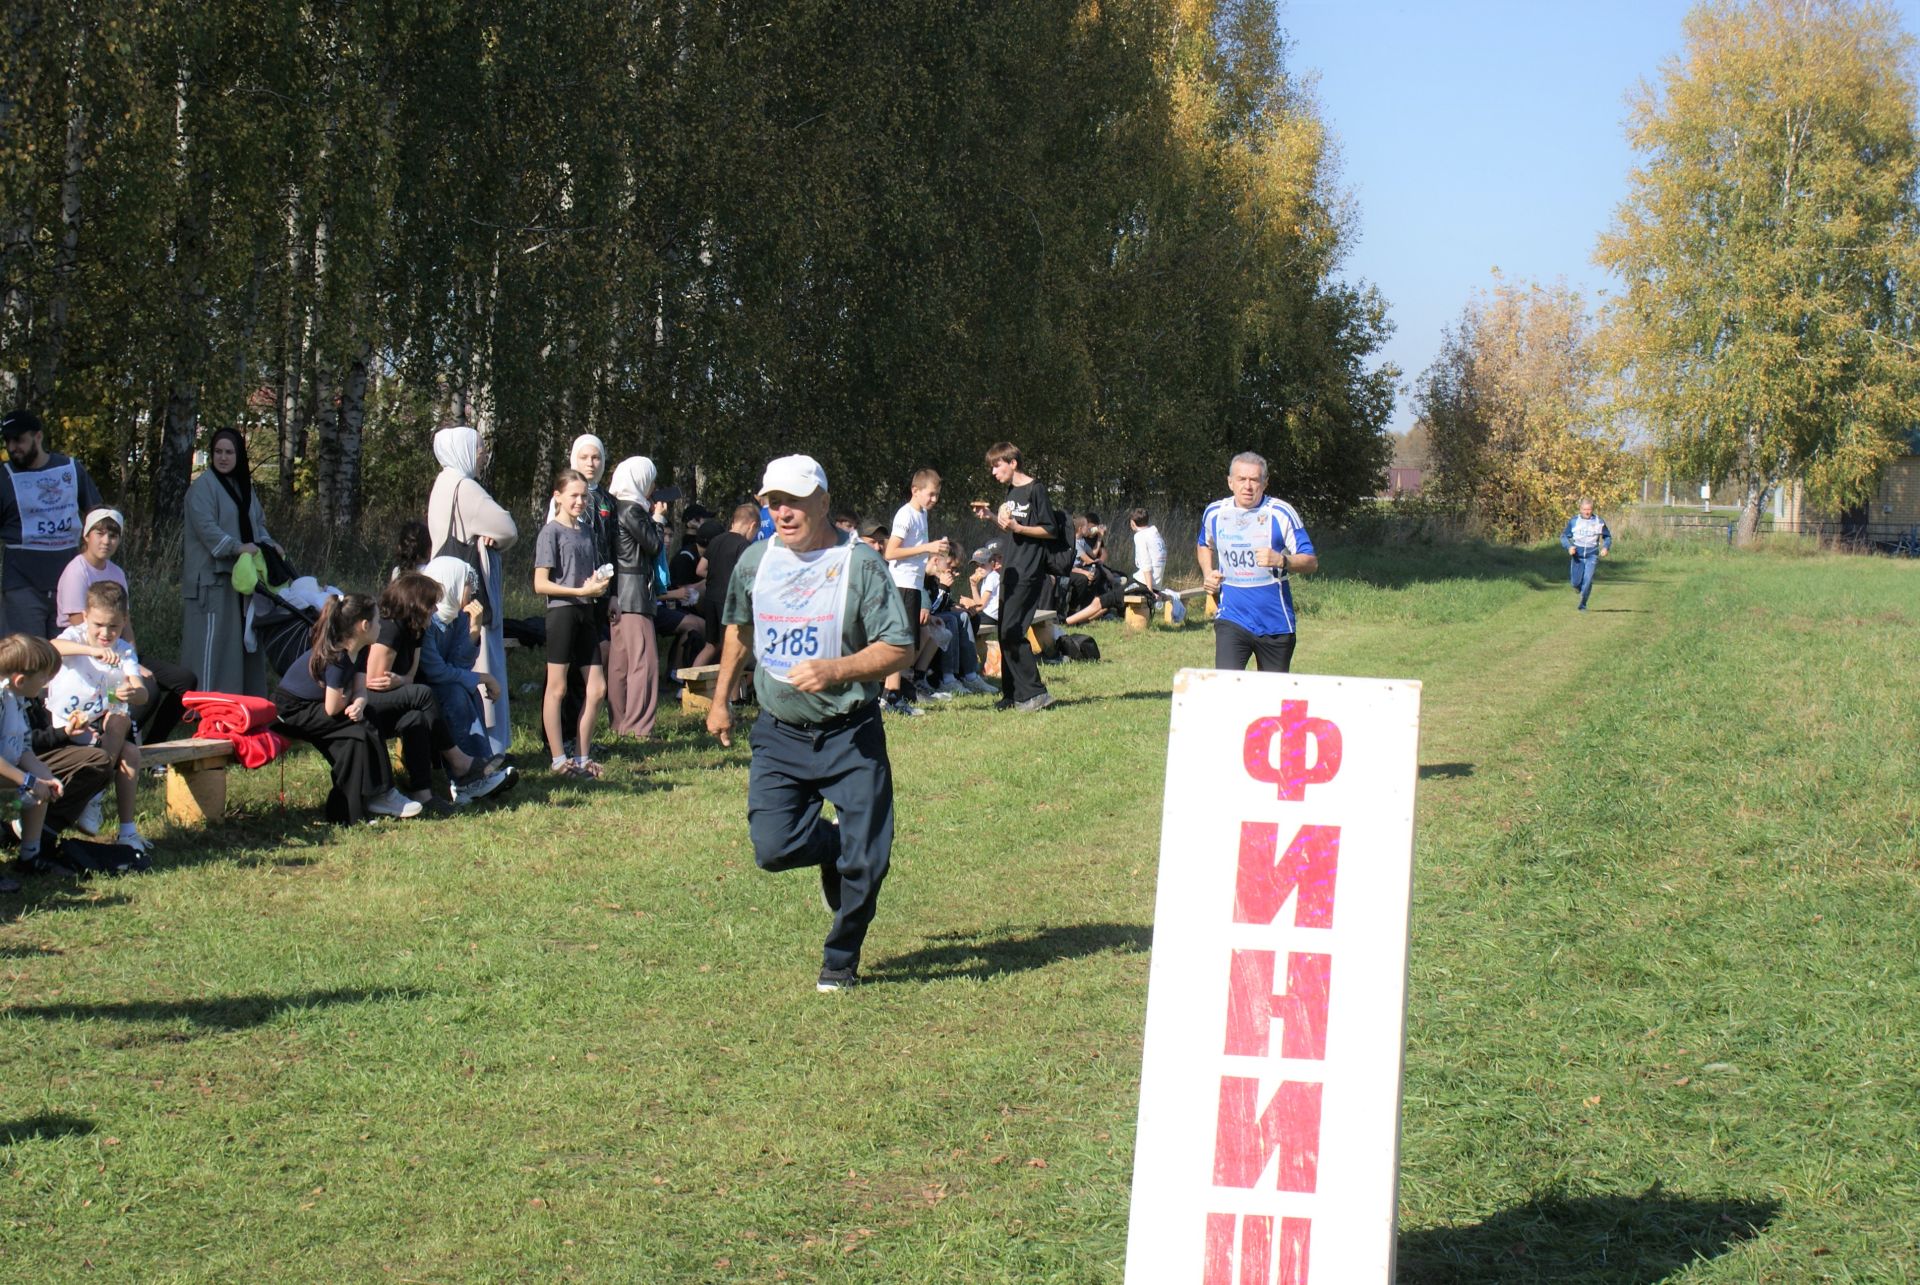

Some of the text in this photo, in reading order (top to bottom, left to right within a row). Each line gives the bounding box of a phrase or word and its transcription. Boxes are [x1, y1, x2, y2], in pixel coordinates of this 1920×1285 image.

[37, 516, 72, 535] 5342
[1224, 550, 1255, 568] 1943
[765, 626, 818, 656] 3185
[1203, 699, 1344, 1285] ФИНИШ
